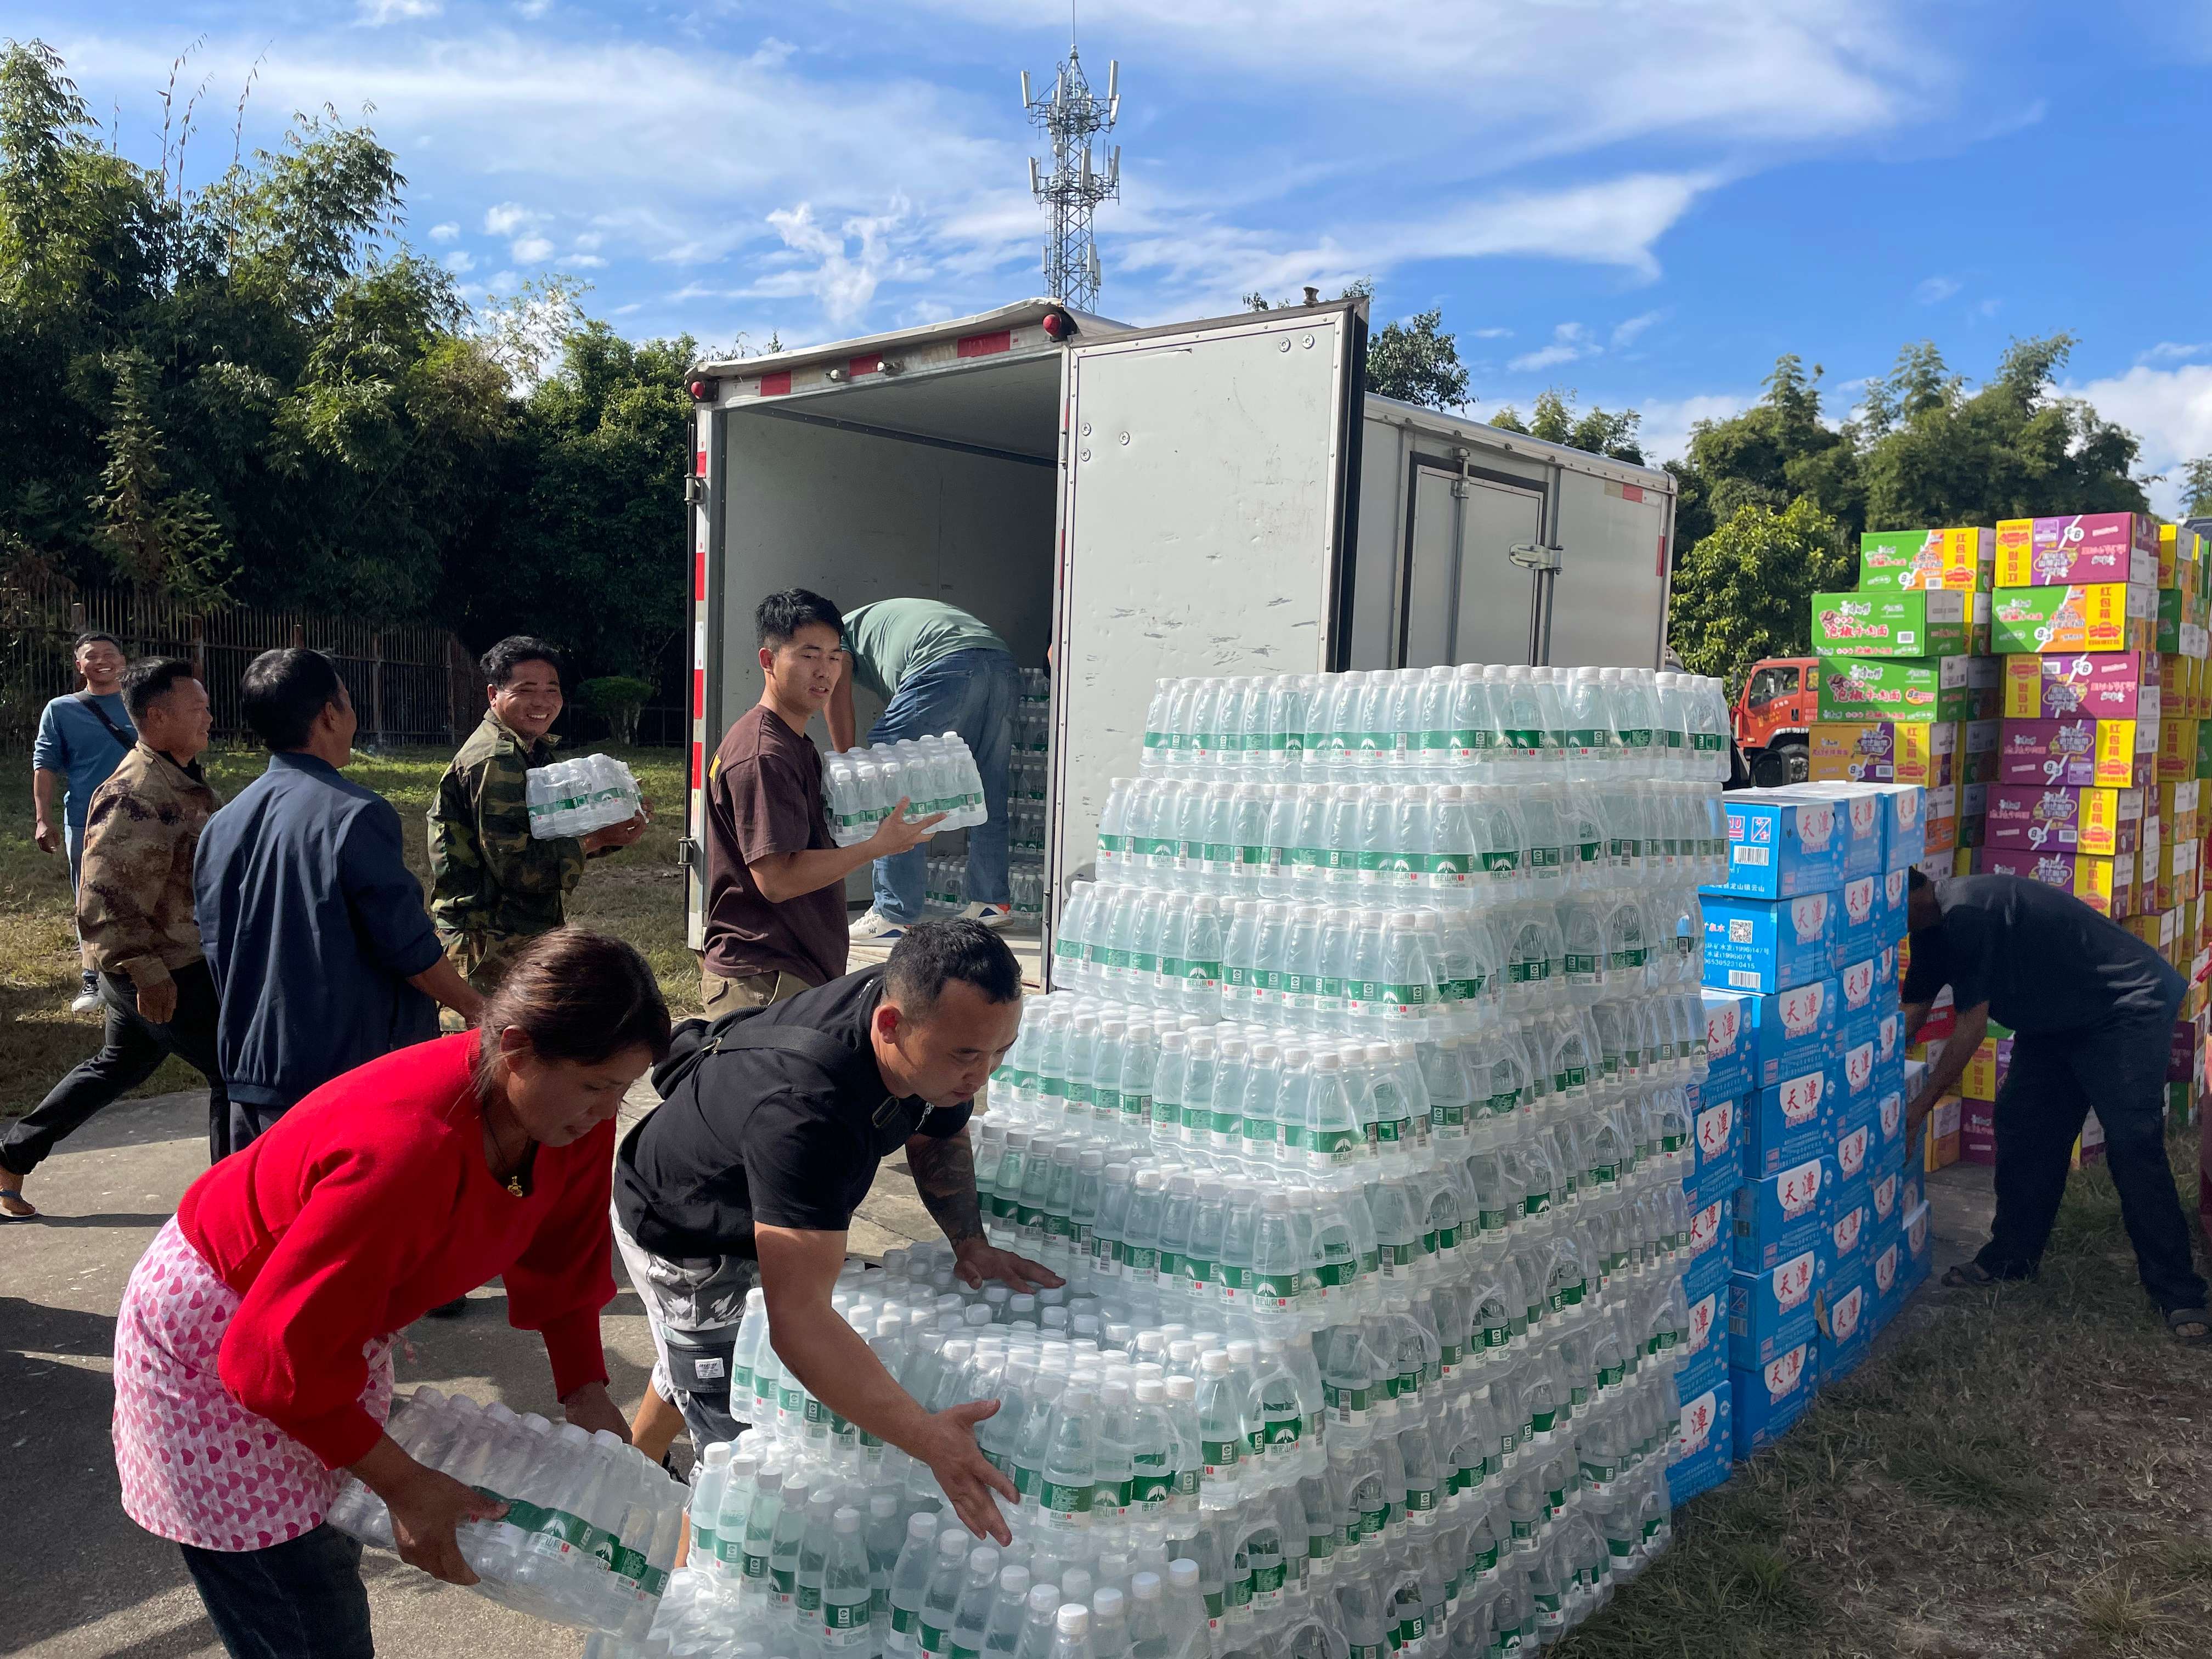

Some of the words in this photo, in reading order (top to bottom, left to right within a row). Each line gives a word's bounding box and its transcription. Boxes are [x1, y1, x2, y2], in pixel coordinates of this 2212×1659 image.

[2100, 587, 2111, 619] 红包箱
[1825, 624, 1888, 639] 泡椒牛肉面
[1833, 688, 1901, 703] 泡椒牛肉面
[1907, 728, 1917, 758] 红包箱
[2109, 724, 2120, 756] 红包箱
[1854, 801, 1871, 826] 天潭
[1900, 795, 1914, 819] 天潭
[2092, 791, 2103, 823] 红包箱
[1804, 812, 1828, 837] 天潭
[1850, 884, 1869, 910] 天潭
[1798, 901, 1822, 929] 天潭
[1848, 968, 1870, 996] 天潭
[1787, 992, 1816, 1022] 天潭
[1707, 1012, 1734, 1043] 天潭
[1849, 1052, 1868, 1078] 天潭
[1787, 1080, 1817, 1111] 天潭
[1703, 1110, 1728, 1146] 天潭
[1844, 1136, 1863, 1164] 天潭
[1785, 1171, 1815, 1204] 天潭
[1690, 1205, 1717, 1239] 天潭
[1838, 1211, 1858, 1240] 天潭
[1779, 1262, 1809, 1297] 天潭
[1694, 1305, 1708, 1333] 潭
[1837, 1296, 1857, 1328] 天潭
[1771, 1350, 1799, 1384] 天潭
[1680, 1406, 1707, 1443] 潭
